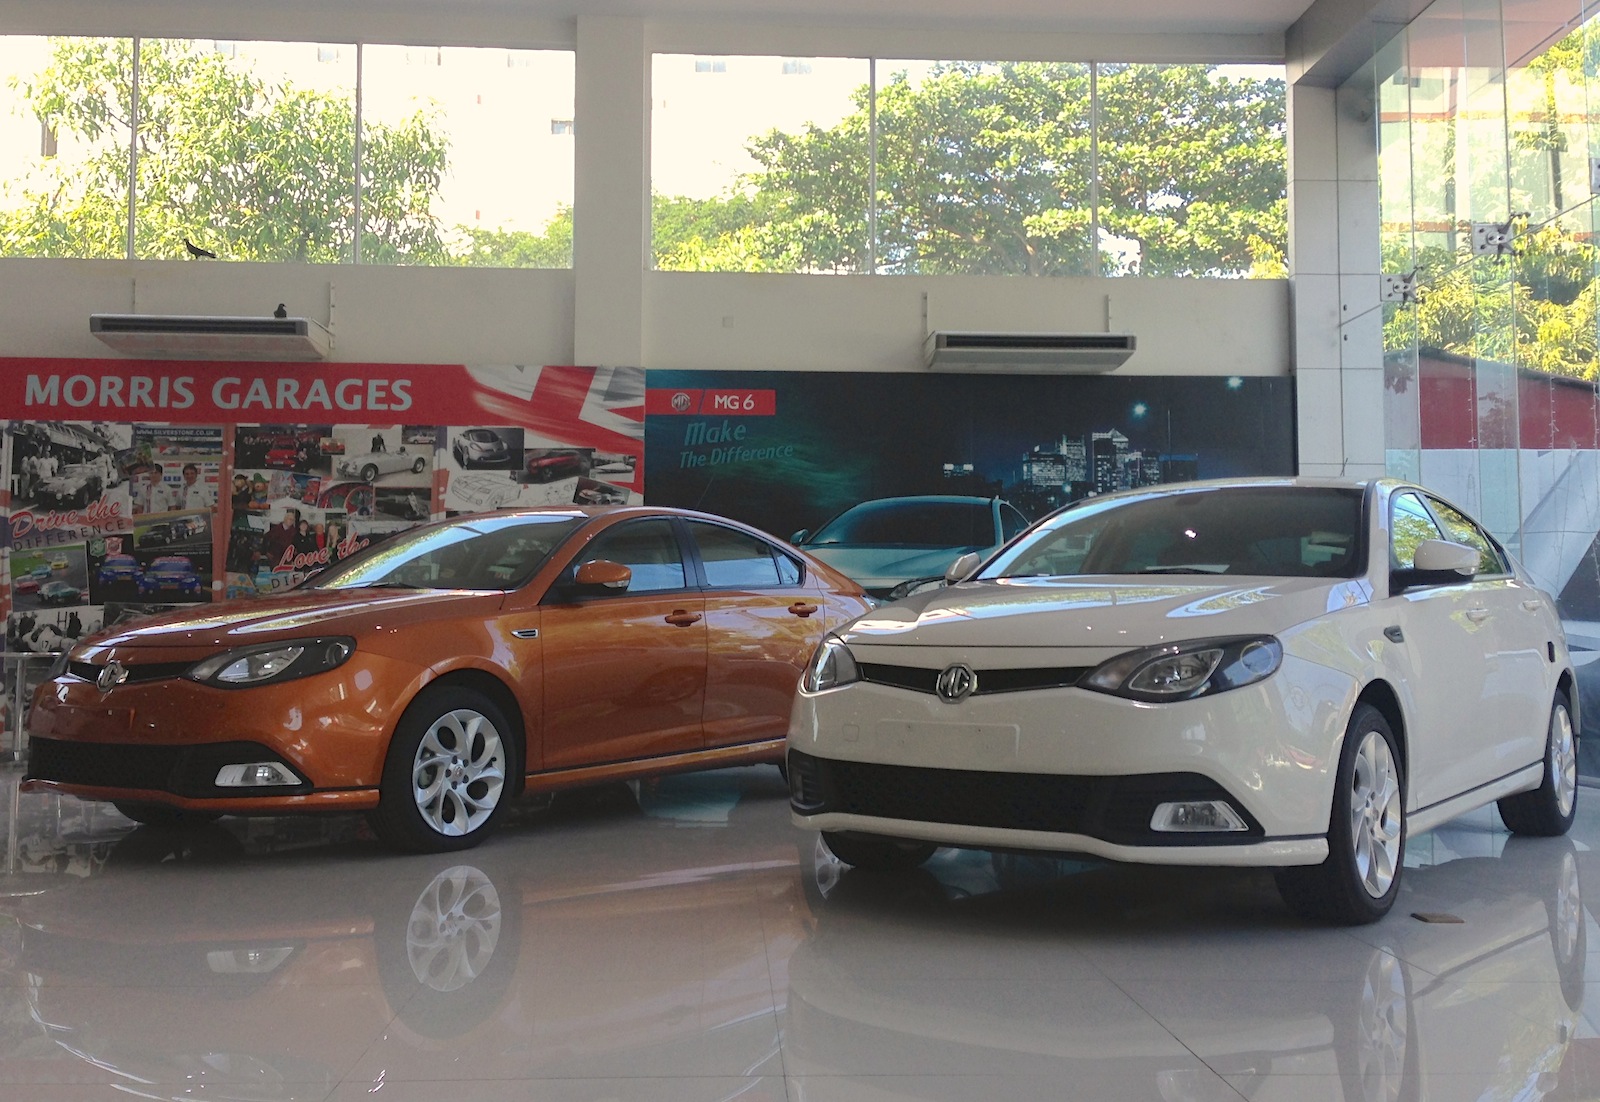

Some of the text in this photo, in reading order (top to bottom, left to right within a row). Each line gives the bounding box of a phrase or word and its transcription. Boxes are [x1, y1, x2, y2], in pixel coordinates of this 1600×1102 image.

[24, 374, 412, 412] MORRIS GARAGES
[714, 394, 755, 410] MG 6
[684, 419, 747, 446] Make
[680, 442, 794, 469] The Difference
[8, 494, 122, 538] Drive the
[13, 519, 125, 552] DIFFERENCE
[272, 544, 329, 574] Love
[938, 666, 972, 700] MG
